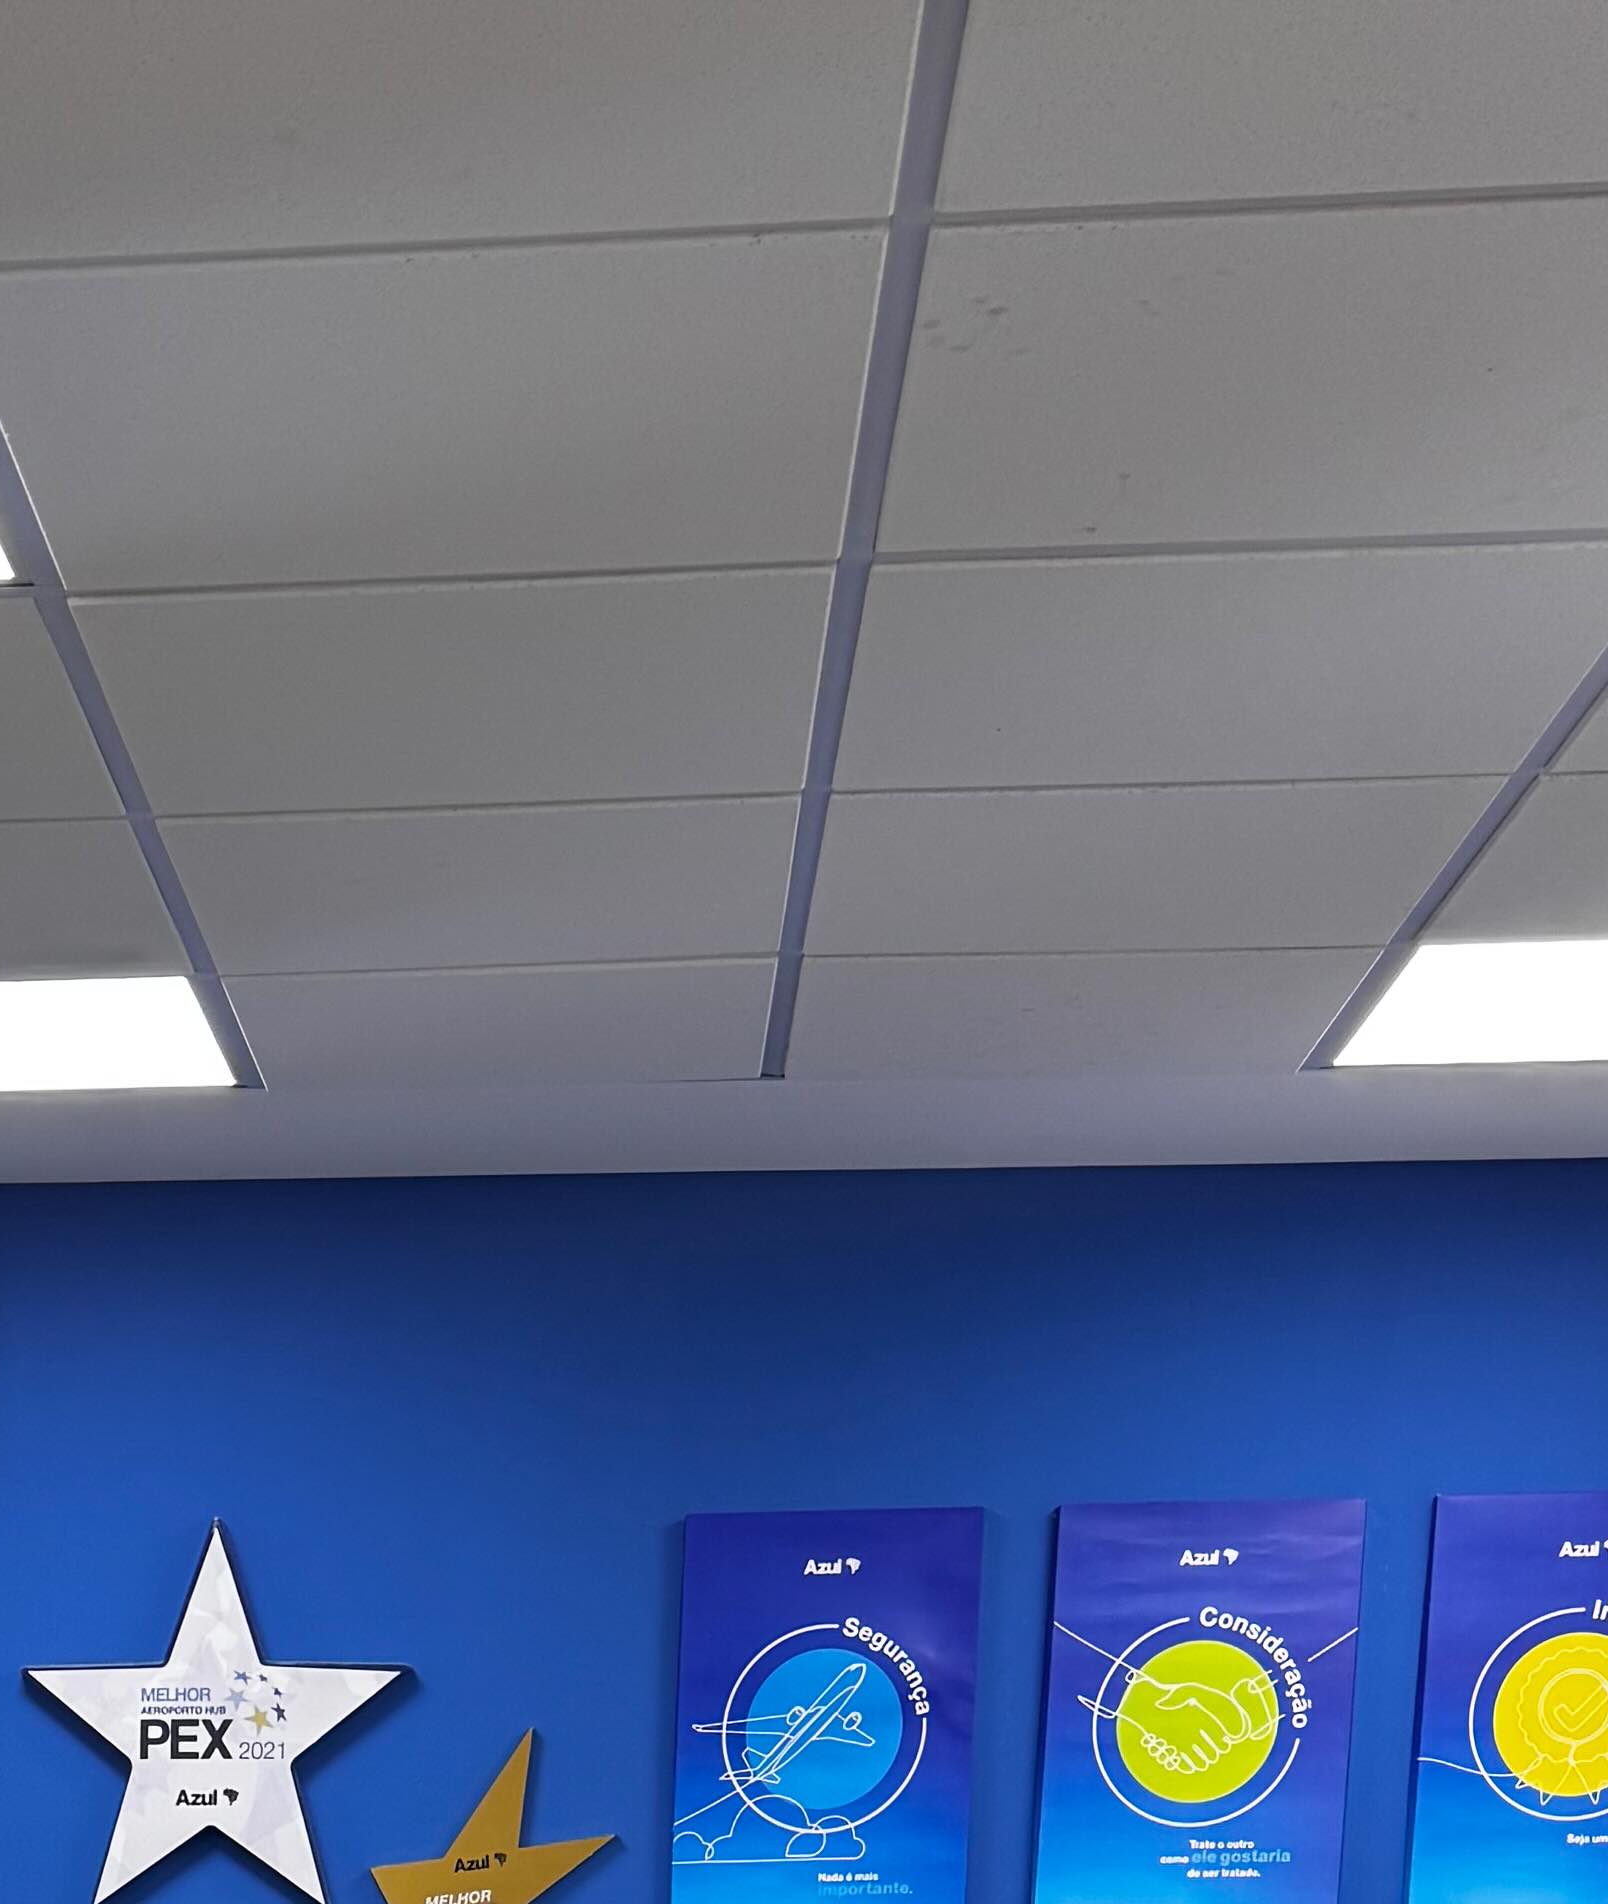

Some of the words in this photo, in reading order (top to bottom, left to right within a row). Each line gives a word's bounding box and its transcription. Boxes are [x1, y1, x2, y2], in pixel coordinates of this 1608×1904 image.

[1179, 1549, 1220, 1567] Azul
[1558, 1540, 1599, 1558] Azul
[804, 1559, 843, 1576] Azul
[842, 1617, 931, 1716] Segurança
[1198, 1606, 1313, 1729] Consideração
[141, 1687, 211, 1702] MELHOR
[141, 1705, 203, 1715] AEROPORTO
[205, 1705, 227, 1715] HUB
[140, 1719, 234, 1760] PEX
[239, 1741, 285, 1760] 2021
[176, 1789, 218, 1806] Azul
[1217, 1841, 1225, 1849] o
[1226, 1840, 1255, 1849] outro
[454, 1854, 490, 1872] Azul
[1191, 1849, 1217, 1863] ele
[1220, 1848, 1292, 1866] gostaria
[817, 1872, 844, 1882] Nada
[854, 1871, 879, 1881] mais
[818, 1881, 913, 1899] importante.
